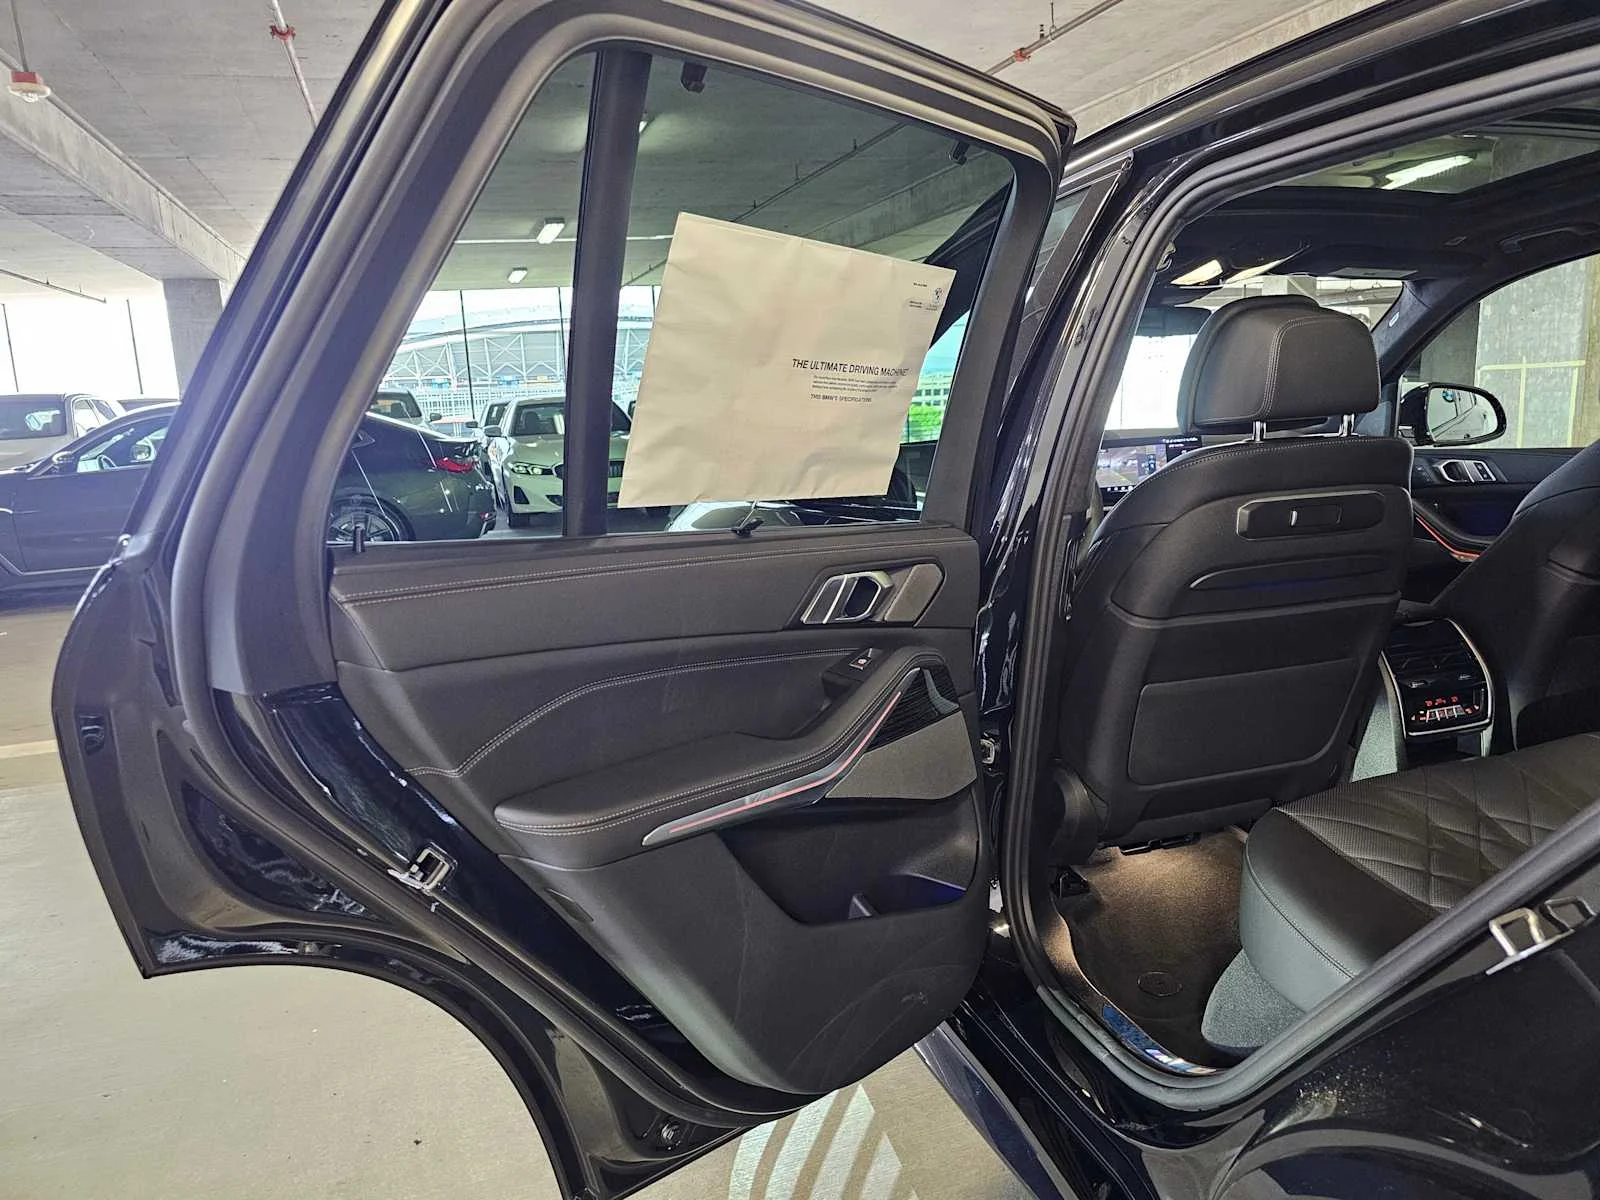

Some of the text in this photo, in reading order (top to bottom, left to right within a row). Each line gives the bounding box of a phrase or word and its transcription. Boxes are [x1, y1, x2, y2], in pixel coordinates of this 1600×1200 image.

[792, 358, 809, 369] THE
[810, 361, 848, 373] ULTIMATE
[849, 364, 879, 376] DRIVING
